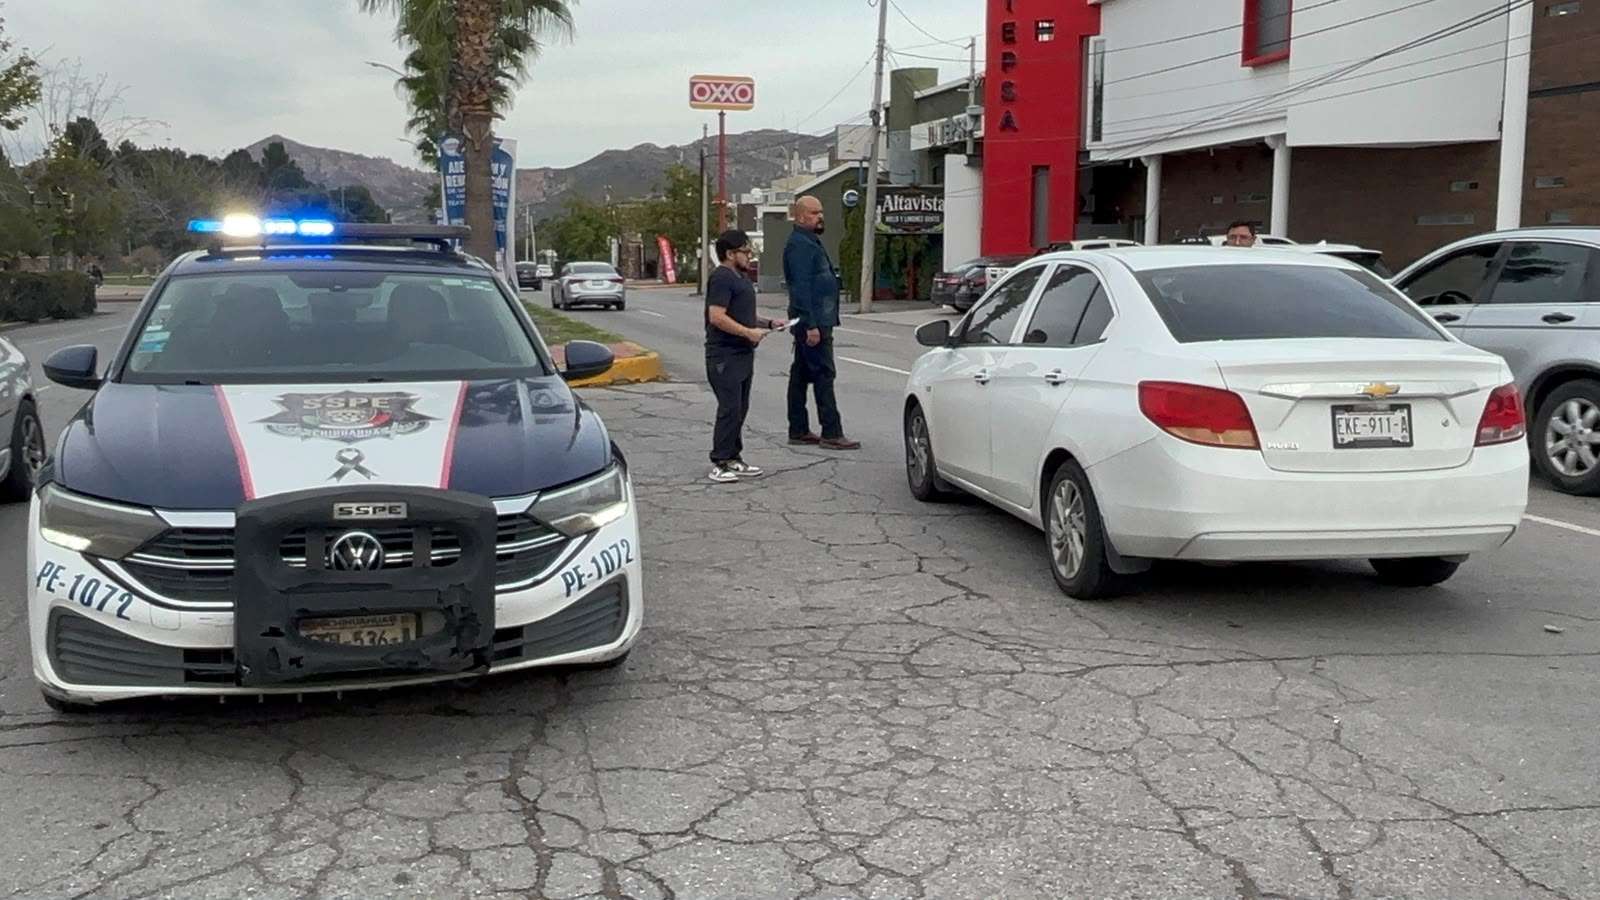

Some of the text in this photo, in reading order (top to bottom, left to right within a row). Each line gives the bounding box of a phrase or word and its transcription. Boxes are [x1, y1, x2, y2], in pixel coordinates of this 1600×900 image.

[693, 83, 752, 103] OXXO
[882, 195, 944, 212] Altavista
[303, 397, 390, 409] SSPE
[1336, 416, 1408, 435] EKE-911-A
[338, 505, 402, 516] SSPE
[560, 538, 634, 598] PE-1072
[36, 560, 134, 621] PE-1072
